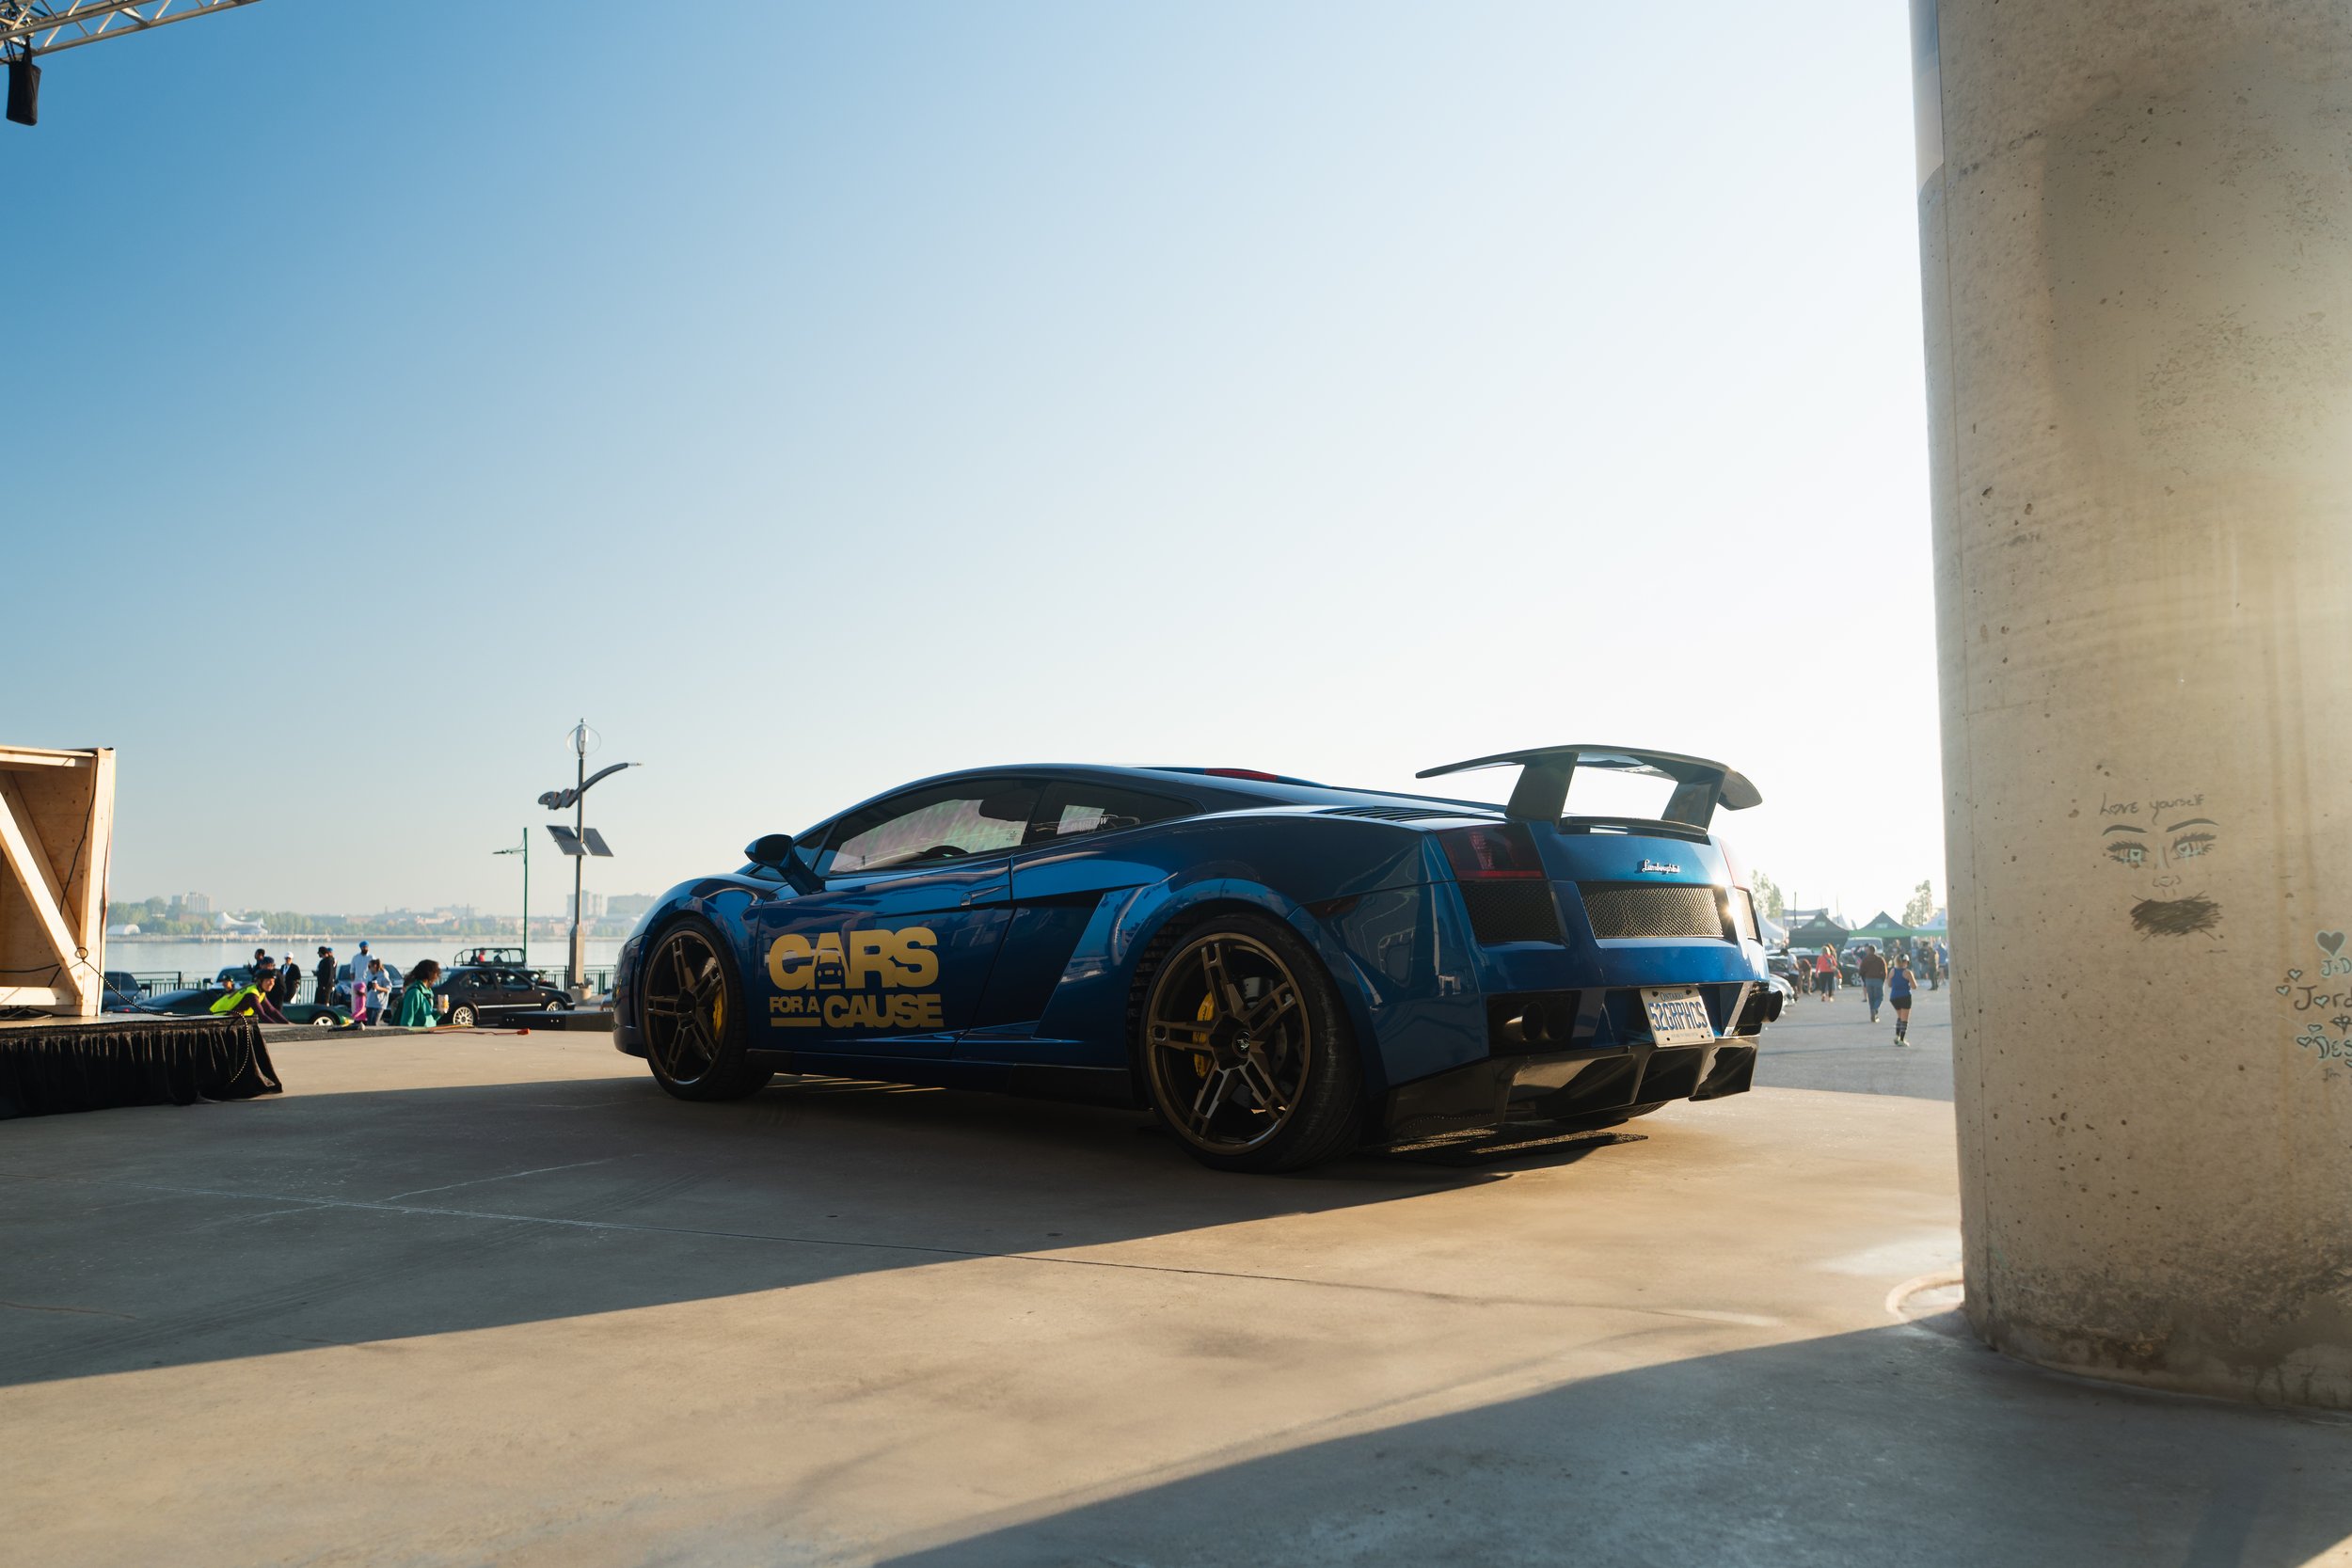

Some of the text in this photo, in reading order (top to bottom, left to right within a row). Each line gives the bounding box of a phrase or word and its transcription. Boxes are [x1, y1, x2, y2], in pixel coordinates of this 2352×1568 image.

[768, 927, 939, 990] CARS
[770, 993, 945, 1028] FOR A CAUSE
[1647, 1001, 1708, 1032] 52GRPHCS
